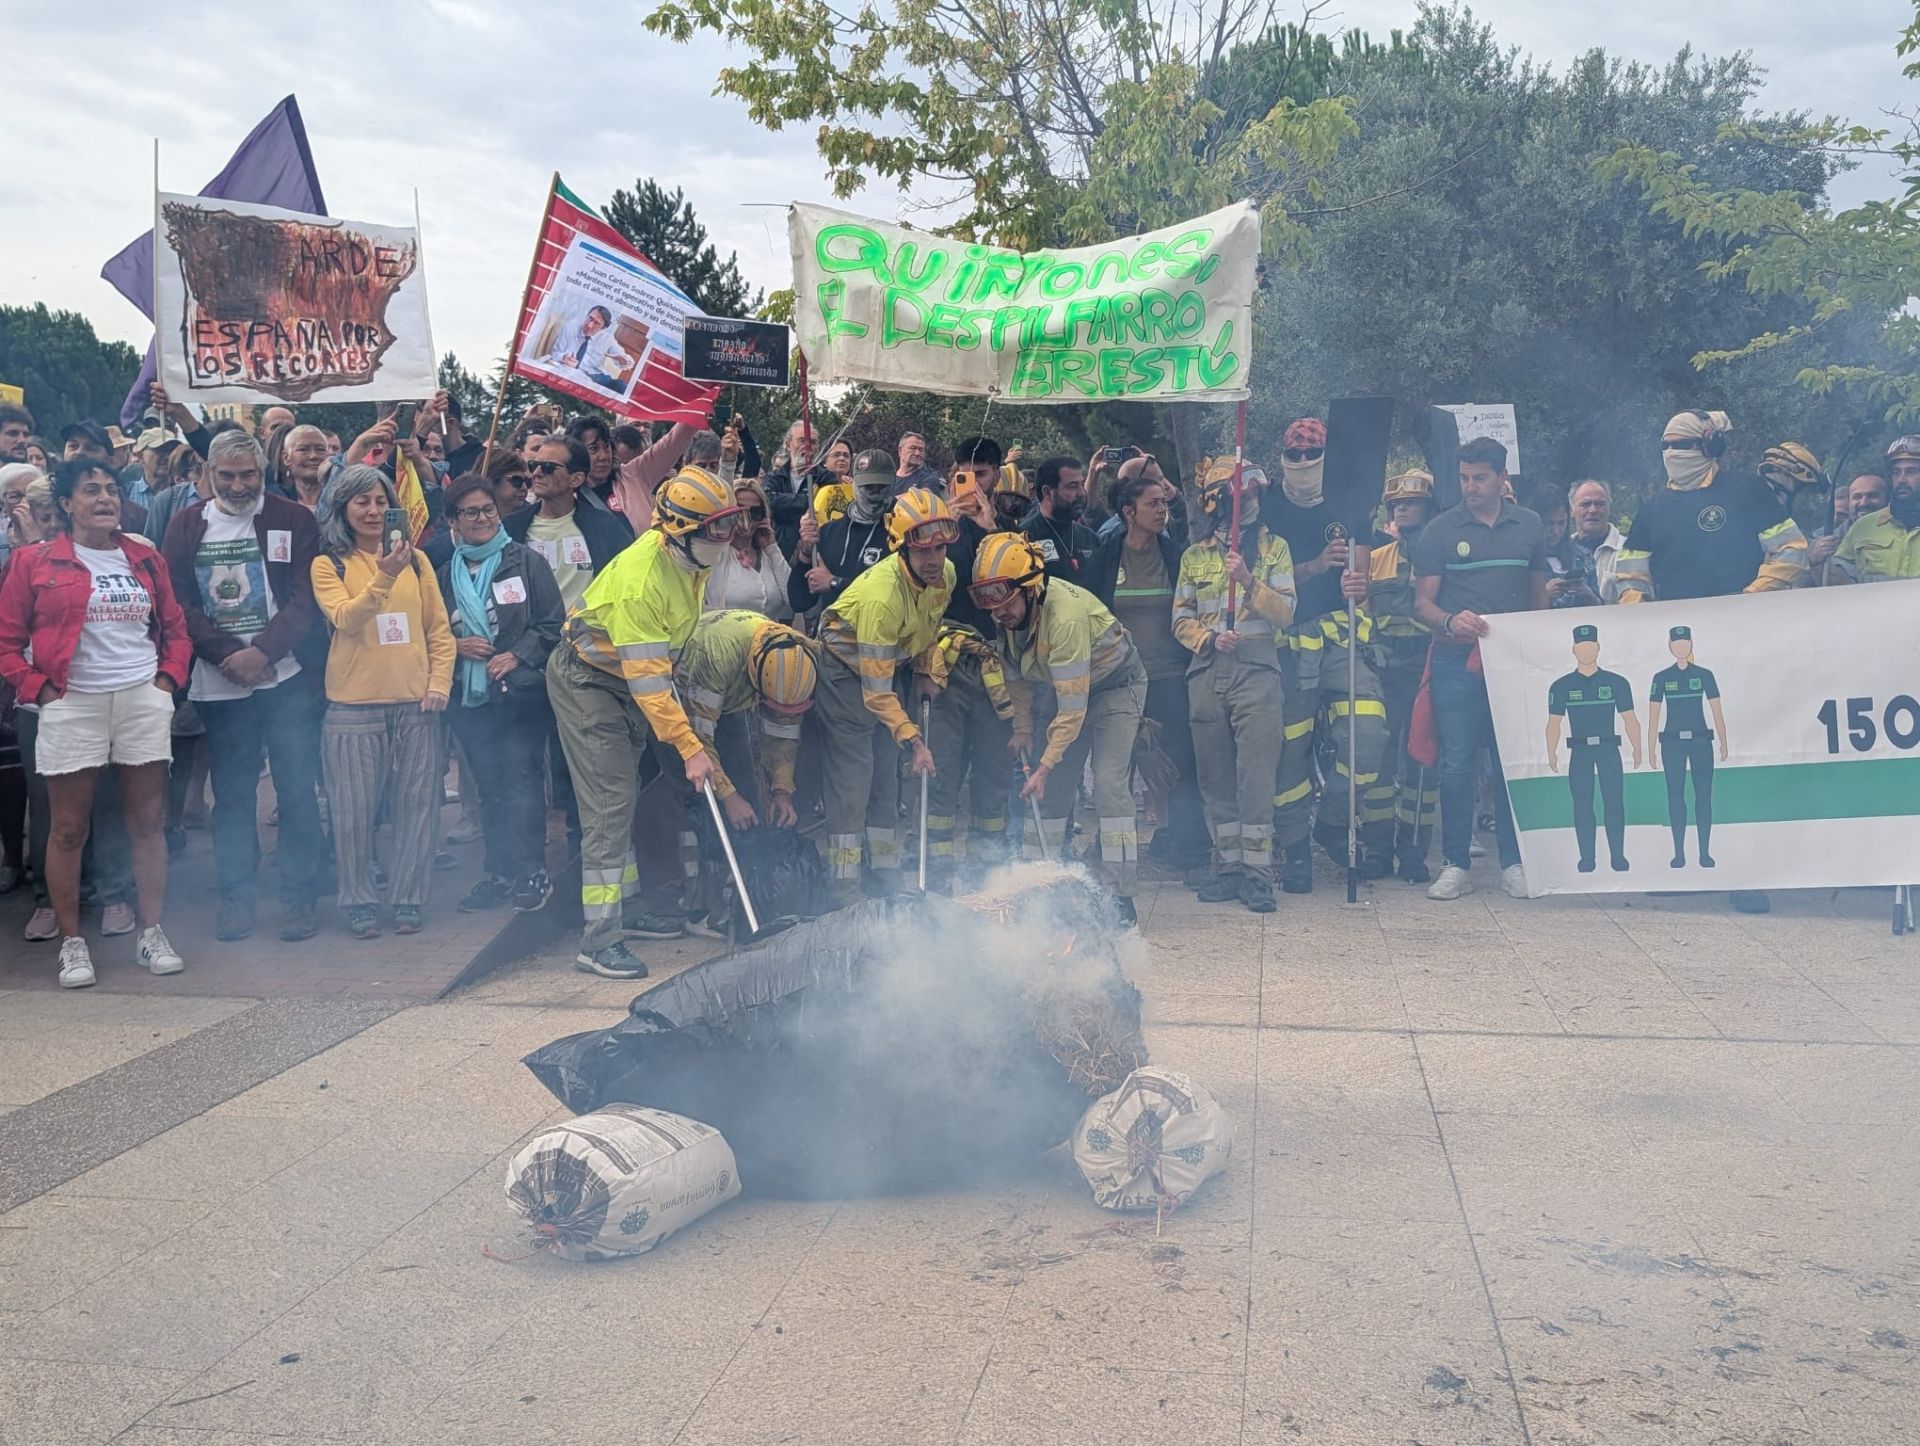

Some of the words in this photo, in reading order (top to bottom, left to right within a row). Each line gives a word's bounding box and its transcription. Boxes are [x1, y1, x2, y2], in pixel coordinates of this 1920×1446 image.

[301, 238, 400, 278] ARDE
[590, 266, 608, 278] Juan
[608, 274, 630, 289] Carlos
[566, 275, 582, 287] todo
[583, 282, 590, 290] el
[590, 286, 605, 297] año
[605, 292, 614, 300] es
[614, 296, 643, 315] absurdo
[649, 314, 660, 324] un
[622, 289, 655, 310] operativo
[655, 307, 665, 315] de
[195, 318, 333, 350] ESPAÑA
[341, 320, 380, 348] POR
[880, 286, 1206, 352] DESPILFARRO
[193, 351, 242, 379] LOS
[252, 349, 371, 381] RECORTES
[95, 574, 140, 589] STO
[1816, 694, 1920, 754] 150
